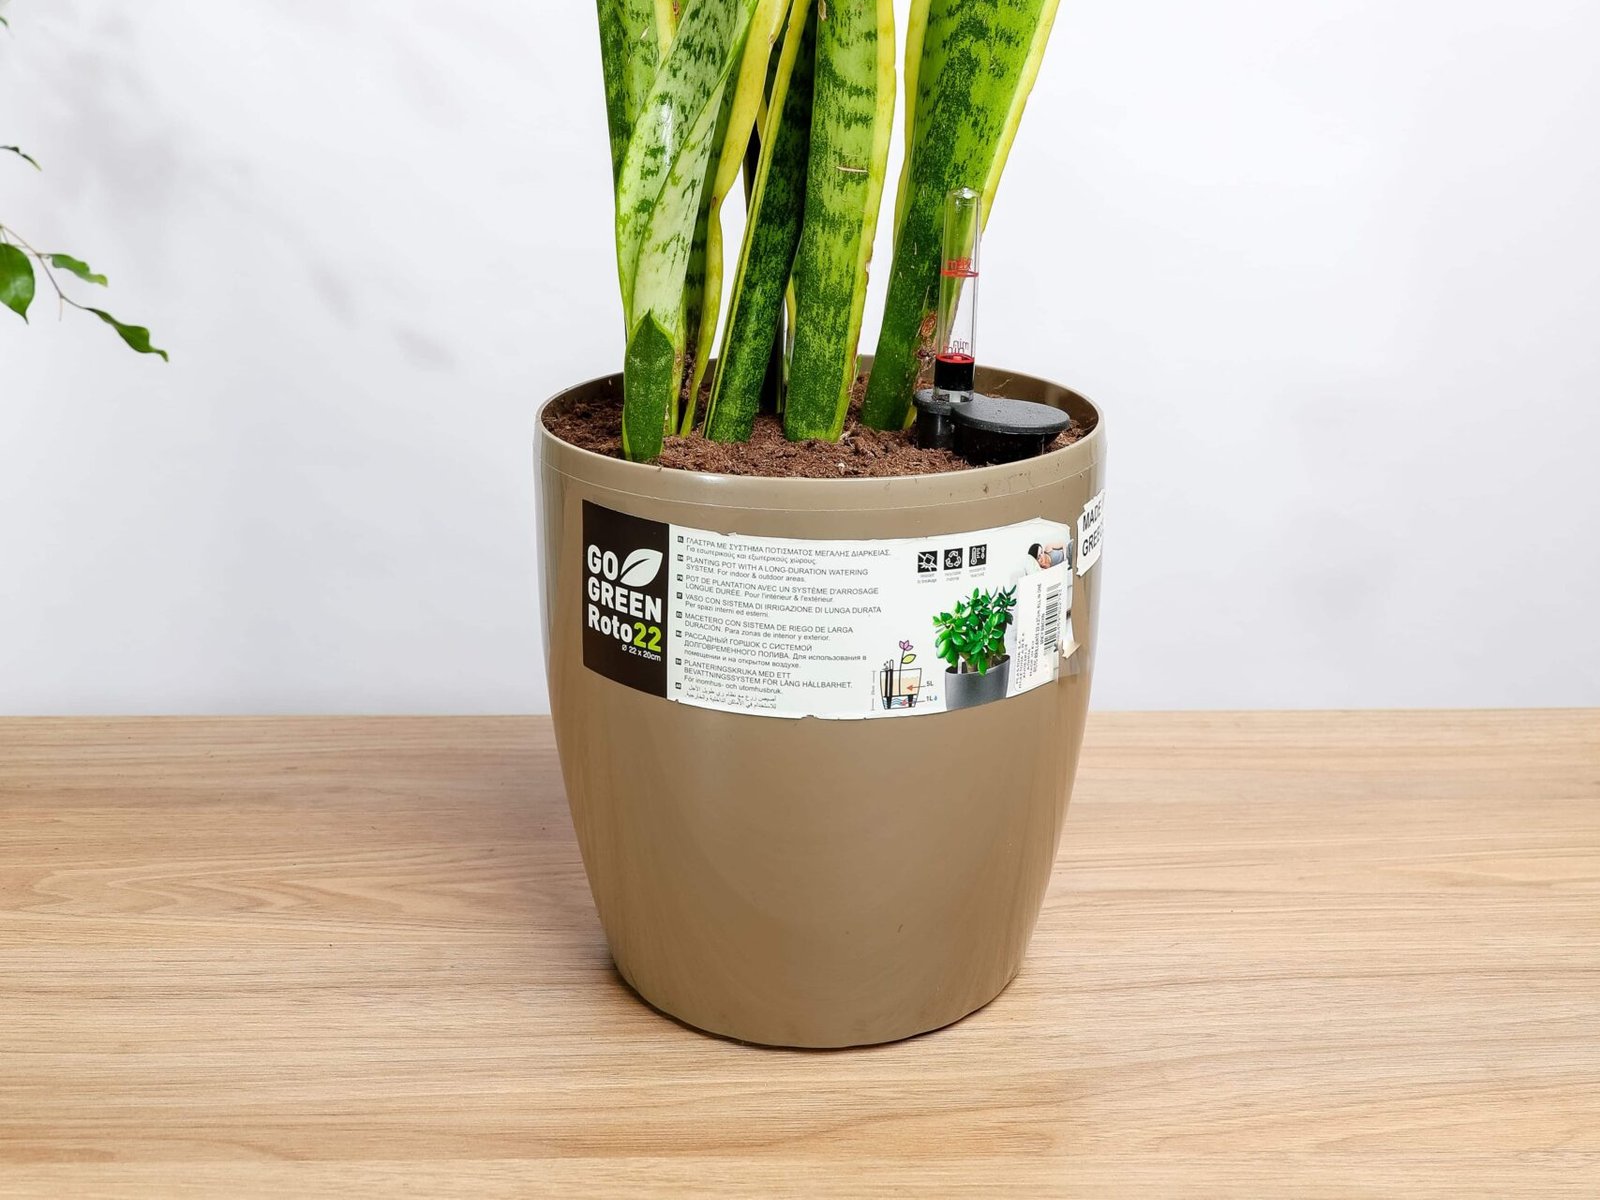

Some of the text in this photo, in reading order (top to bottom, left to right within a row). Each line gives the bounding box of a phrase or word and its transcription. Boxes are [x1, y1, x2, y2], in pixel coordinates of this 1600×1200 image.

[686, 537, 715, 548] ΓΛΑΣΤΡΑ
[729, 543, 764, 553] ΣΥΣΤΗΜΑ
[765, 547, 813, 556] ΠΟΤΙΣΜΑΤΟΣ
[588, 544, 618, 580] GO
[686, 556, 720, 567] PLANTING
[738, 563, 756, 571] WITH
[765, 566, 826, 575] LONG-DURATION
[686, 564, 714, 573] SYSTEM.
[758, 573, 784, 581] outdoor
[686, 574, 699, 582] POT
[712, 579, 756, 590] PLANTATION
[757, 584, 777, 592] AVEC
[830, 587, 879, 595] D'ARROSAGE
[686, 583, 714, 593] LONGUE
[762, 592, 792, 600] l'intérieur
[588, 576, 662, 623] GREEN
[685, 593, 703, 602] VASO
[705, 597, 721, 605] CON
[722, 599, 754, 609] SISTEMA
[764, 603, 813, 613] IRRIGAZIONE
[852, 606, 882, 614] DURATA
[697, 604, 713, 612] spazi
[715, 606, 735, 614] interni
[588, 603, 662, 652] Roto22
[685, 612, 724, 625] MACETERO
[725, 619, 741, 627] CON
[742, 621, 775, 630] SISTEMA
[777, 624, 787, 632] DE
[789, 625, 813, 633] RIEGO
[827, 626, 853, 634] LARGA
[684, 640, 756, 656] ДОЛГОВРЕМЕННОГО
[758, 650, 790, 659] ПОЛИВА.
[685, 631, 728, 644] РАССАДНЫЙ
[730, 639, 760, 648] ГОРШОК
[769, 643, 812, 652] СИСТЕМОЙ
[629, 646, 637, 655] 22
[643, 650, 662, 661] 20cm
[684, 649, 721, 660] помещении
[738, 658, 770, 667] открытом
[684, 659, 757, 676] PLANTERINGSKRUKA
[758, 670, 775, 678] MED
[684, 667, 760, 684] BEVATTNINGSSYSTEM
